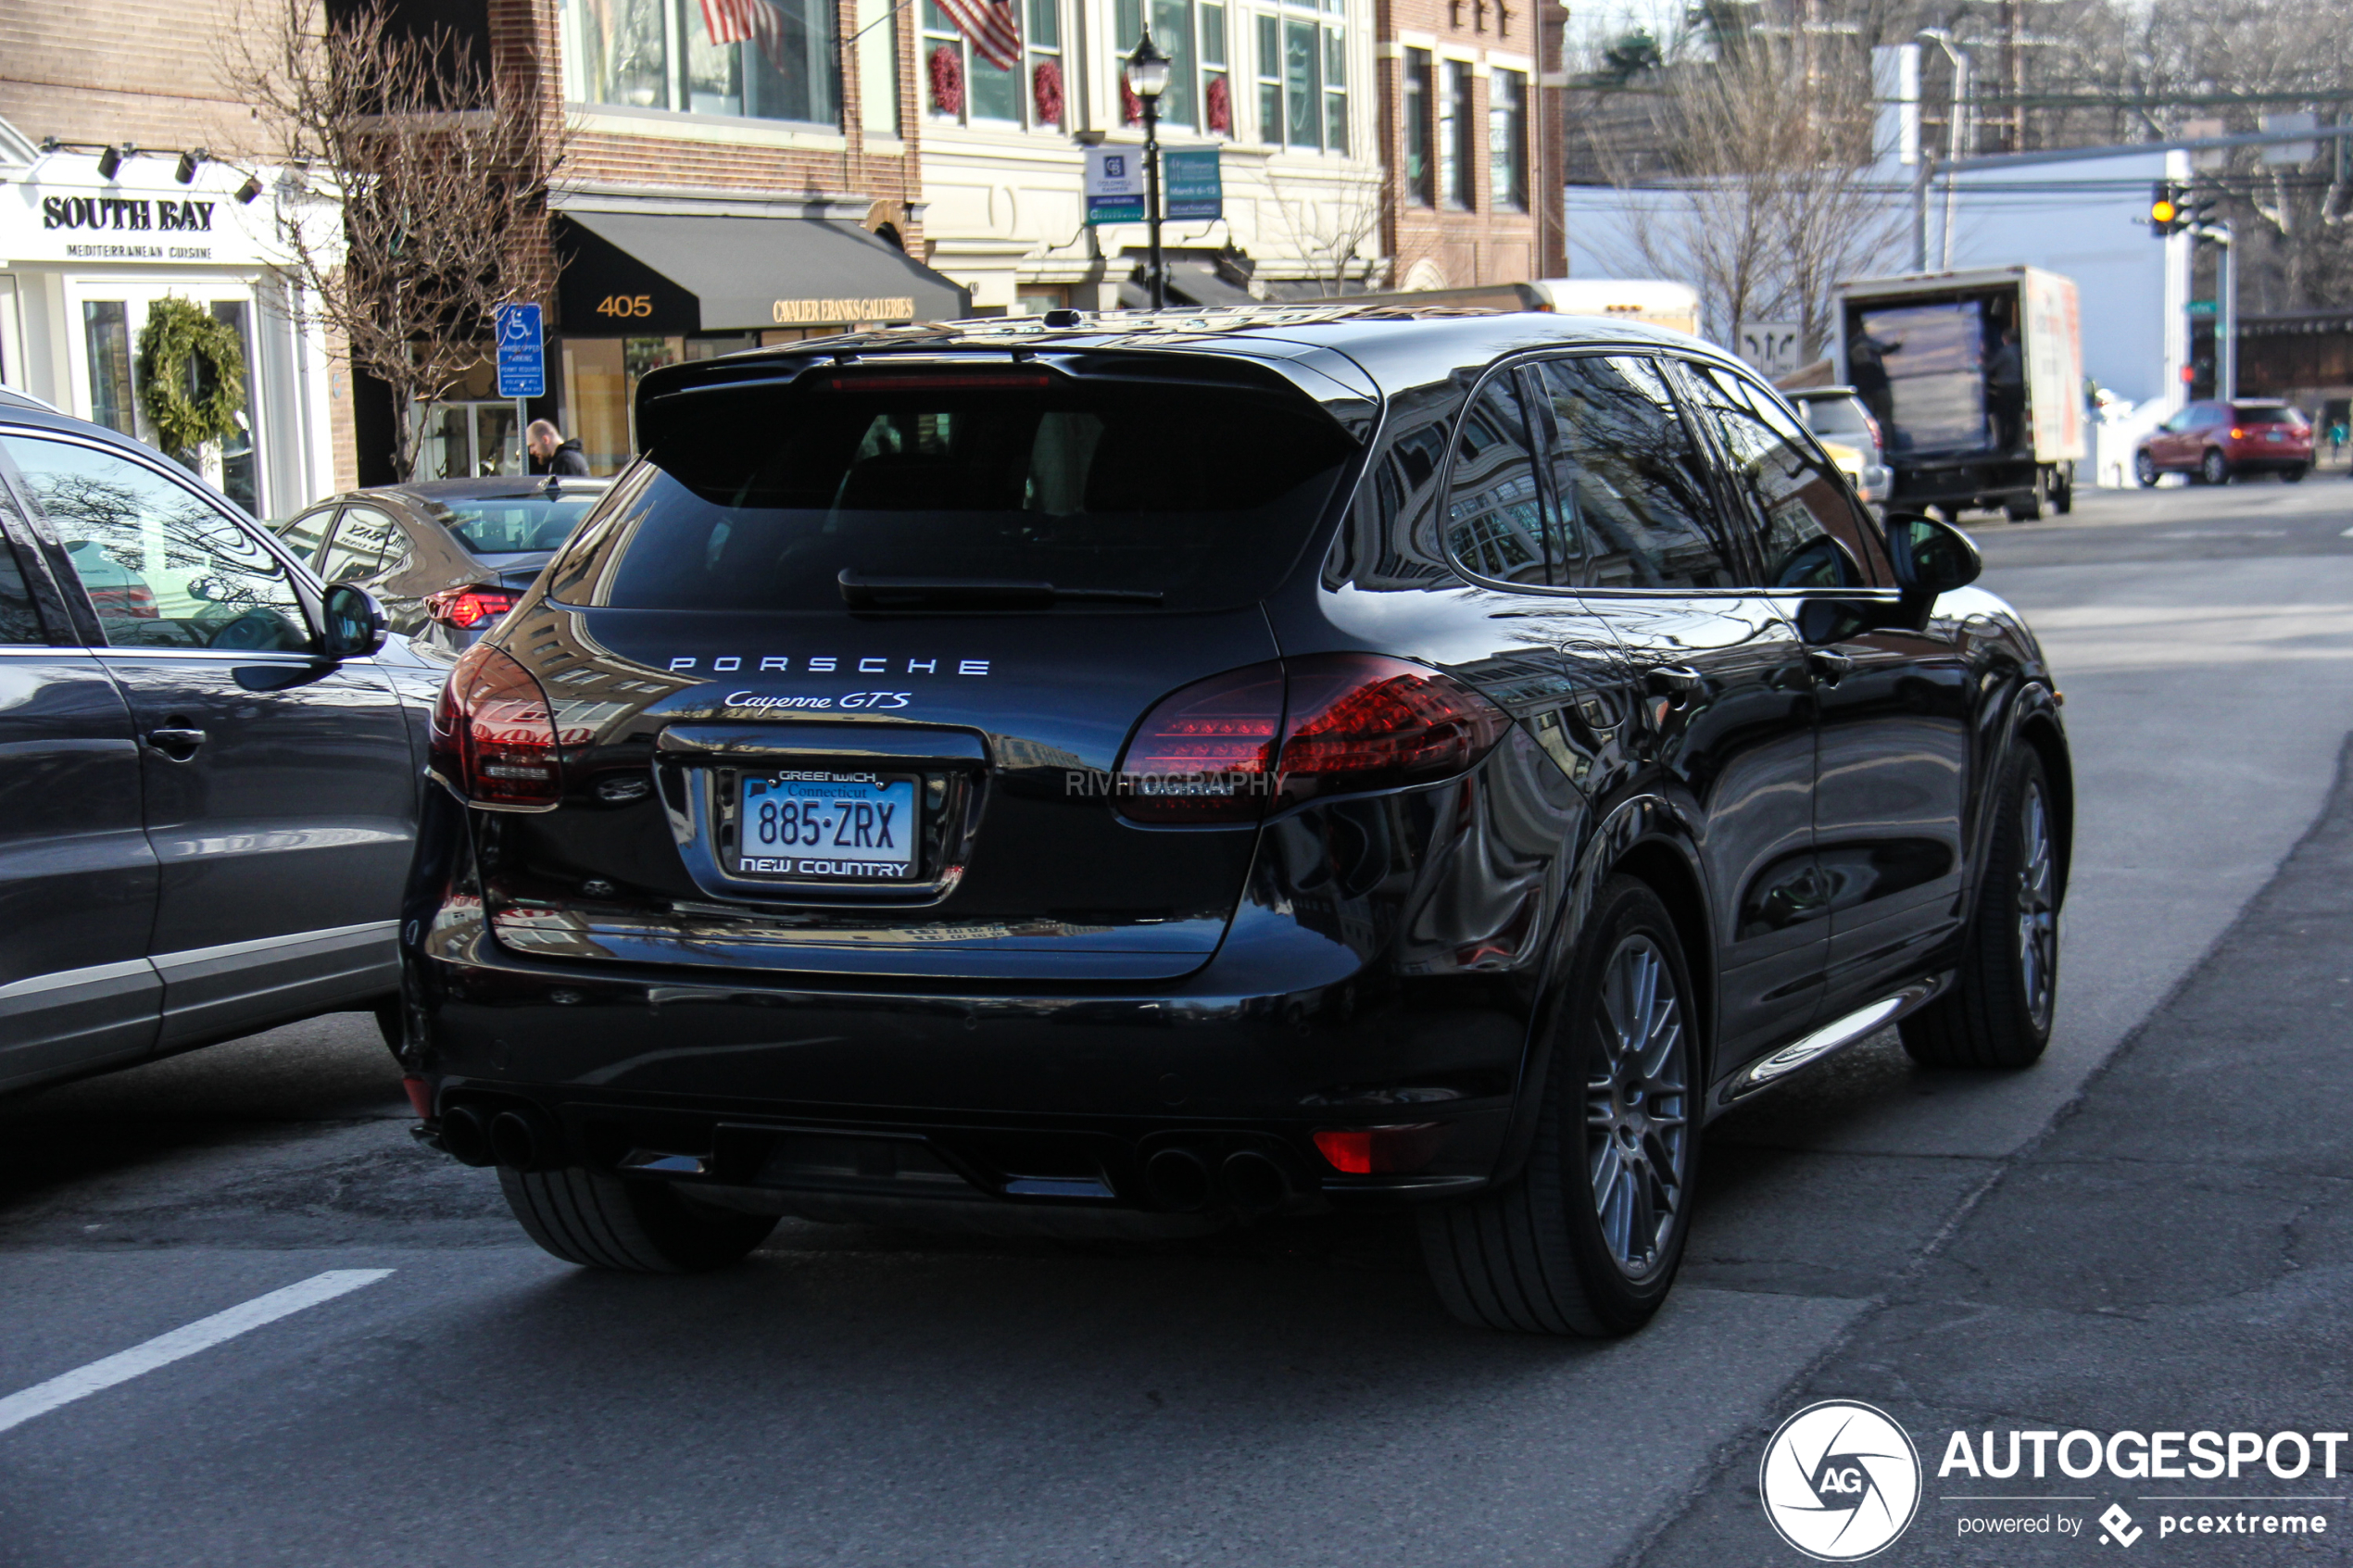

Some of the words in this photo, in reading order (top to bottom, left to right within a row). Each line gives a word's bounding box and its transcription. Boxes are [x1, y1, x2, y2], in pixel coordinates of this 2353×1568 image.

[43, 195, 152, 231] SOUTH
[157, 199, 216, 232] BAY
[67, 245, 163, 258] MEDITERRANEAN
[169, 246, 212, 259] CUISINE
[596, 295, 652, 317] 405
[773, 298, 820, 323] CAVALIER
[821, 297, 860, 321] EBANKS
[861, 296, 914, 320] GALLERIES
[670, 657, 990, 675] PORSCHE
[724, 691, 832, 716] Cayenne
[838, 691, 912, 709] GTS
[779, 771, 876, 783] GREENWICH
[787, 784, 867, 798] Connecticut
[740, 858, 791, 873] NEW
[799, 859, 909, 877] COUNTRY
